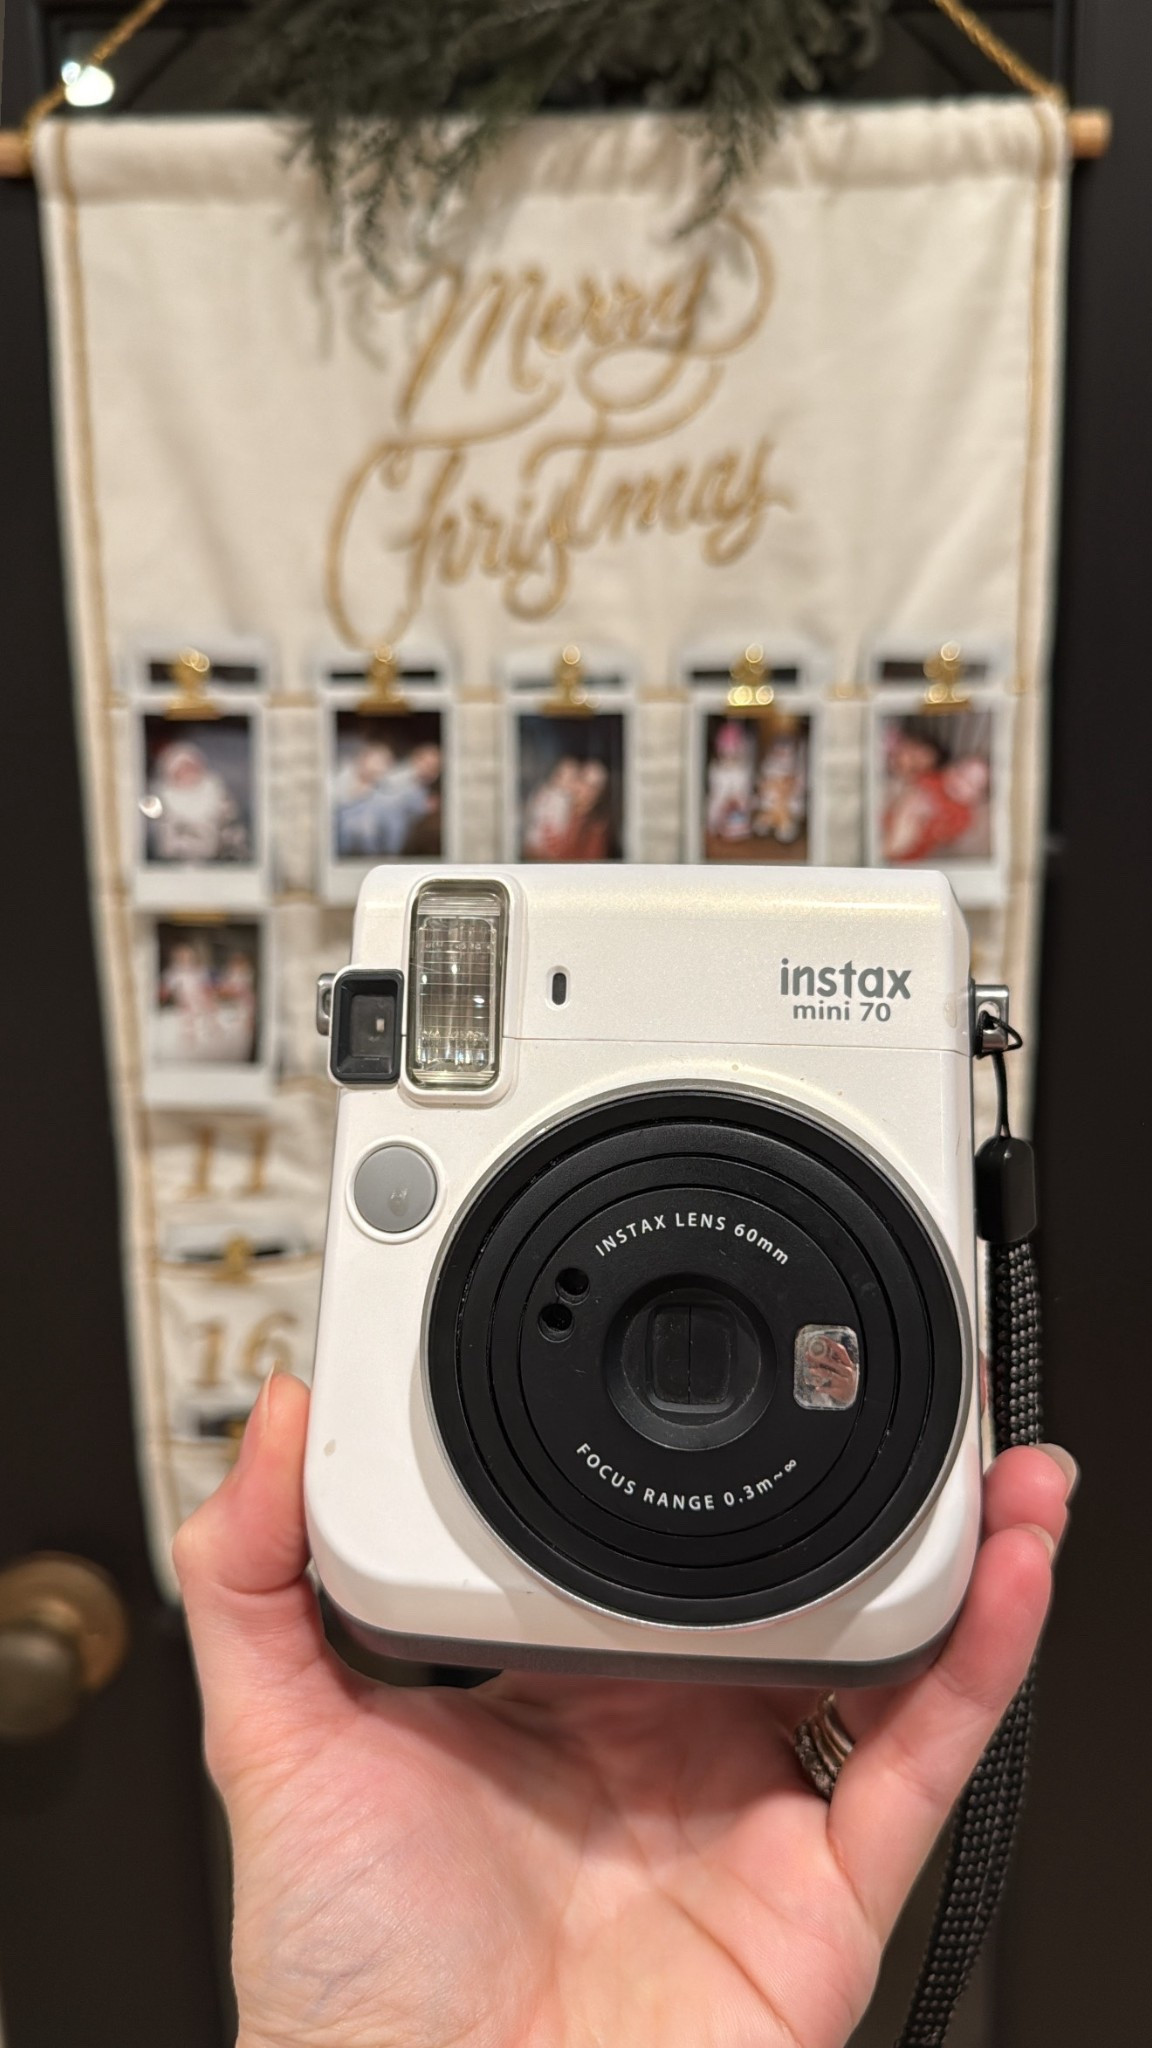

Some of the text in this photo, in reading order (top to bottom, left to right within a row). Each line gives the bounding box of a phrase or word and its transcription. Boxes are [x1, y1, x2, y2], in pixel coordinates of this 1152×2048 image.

[780, 957, 912, 1000] instax
[793, 999, 891, 1022] mini 70
[594, 1212, 790, 1266] INSTAX LENS 60mm
[576, 1442, 637, 1496] FOCUS
[643, 1487, 715, 1511] RANGE
